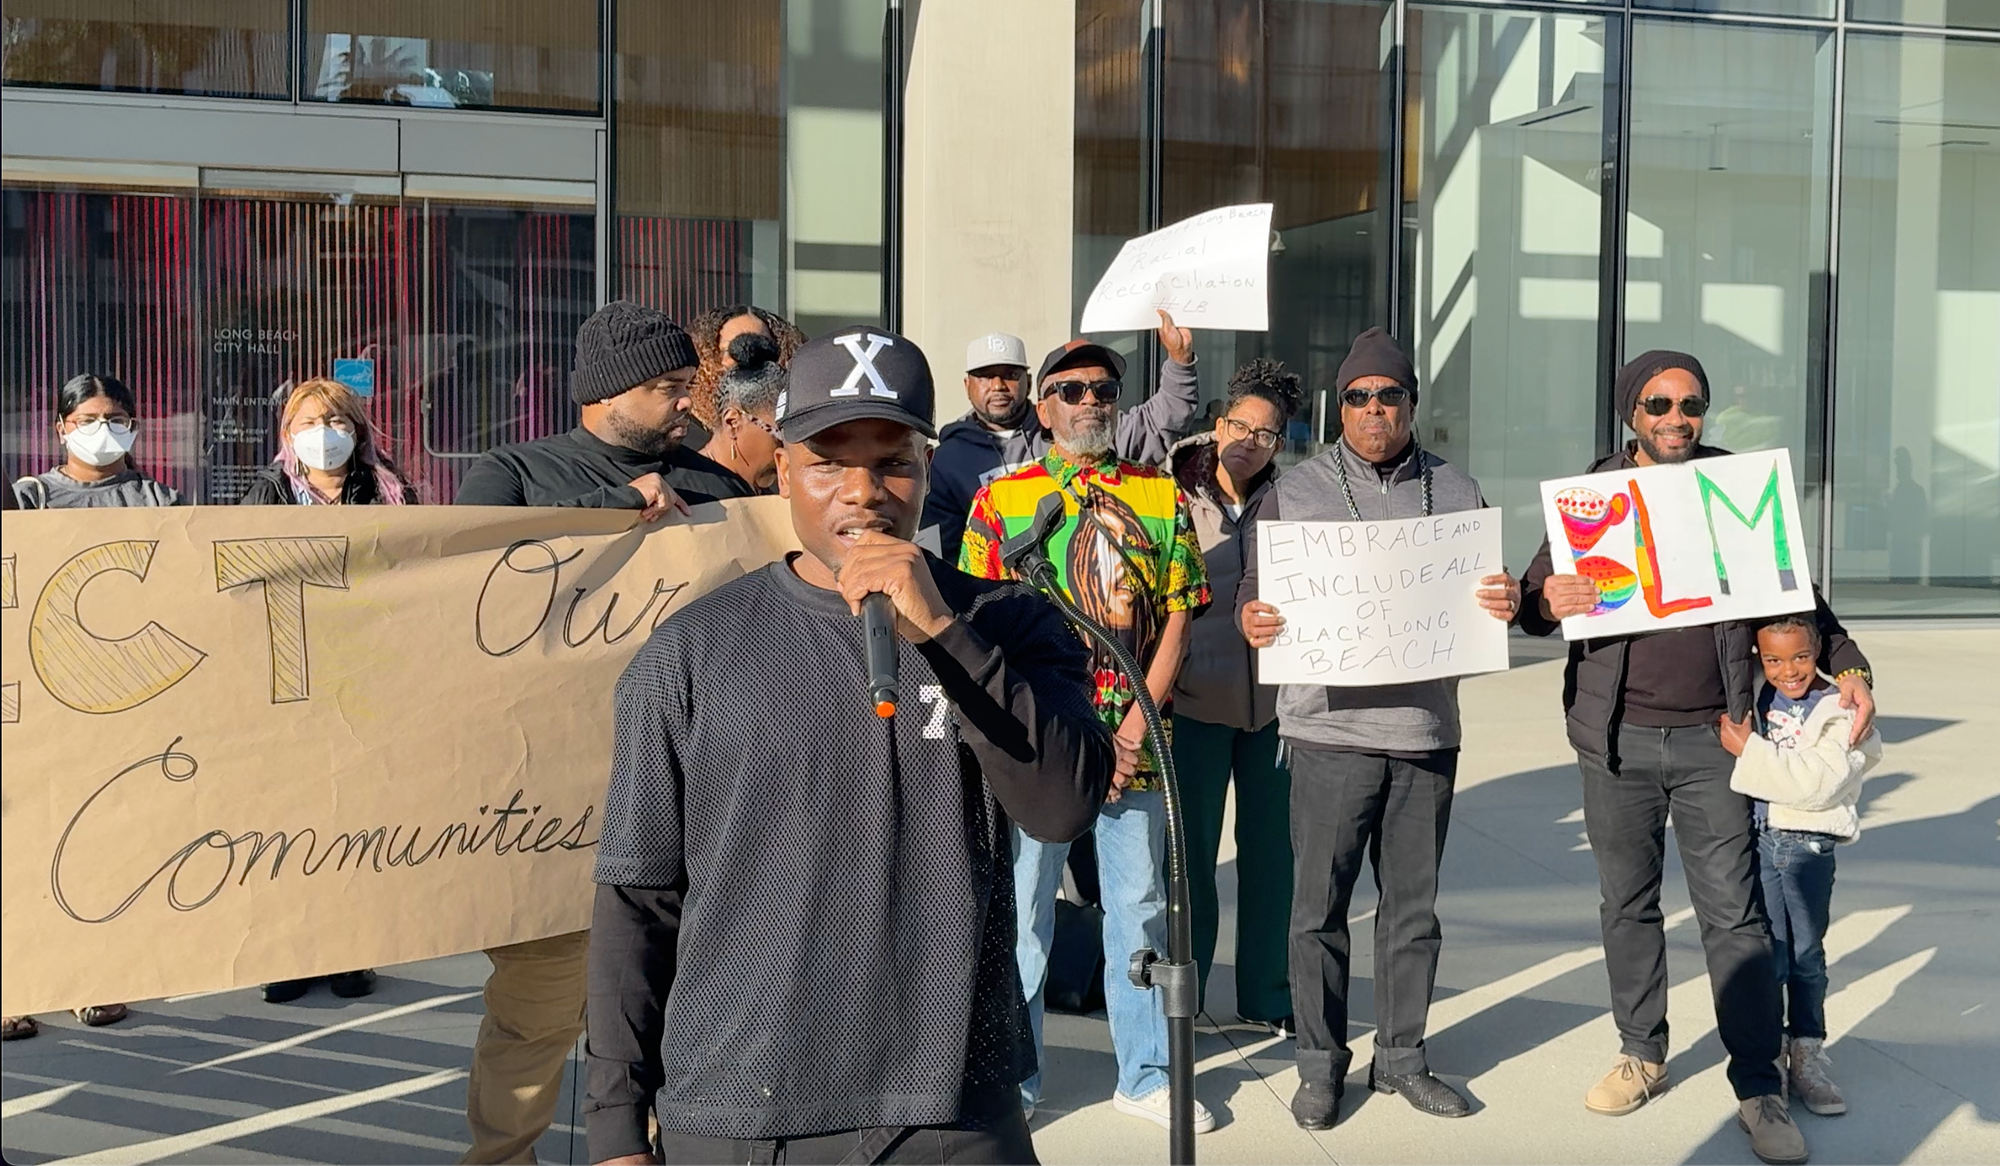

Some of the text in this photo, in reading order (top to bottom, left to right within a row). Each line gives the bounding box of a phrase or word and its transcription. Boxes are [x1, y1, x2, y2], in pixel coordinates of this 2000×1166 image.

[1197, 213, 1224, 226] Long
[1129, 238, 1206, 274] Racial
[213, 342, 281, 354] CITY HALL
[214, 328, 301, 341] LONG BEACH
[830, 333, 898, 399] X
[212, 396, 289, 406] MAIN ENTRANC
[1266, 518, 1481, 565] EMBRACE AND
[1553, 458, 1799, 619] BLM
[1275, 553, 1487, 604] INCLUDE ALL
[2, 536, 689, 723] CT Our
[1275, 611, 1451, 648] BLACK LONG
[1356, 598, 1393, 621] OF
[1300, 632, 1457, 676] BEACH
[50, 736, 601, 924] Communities
